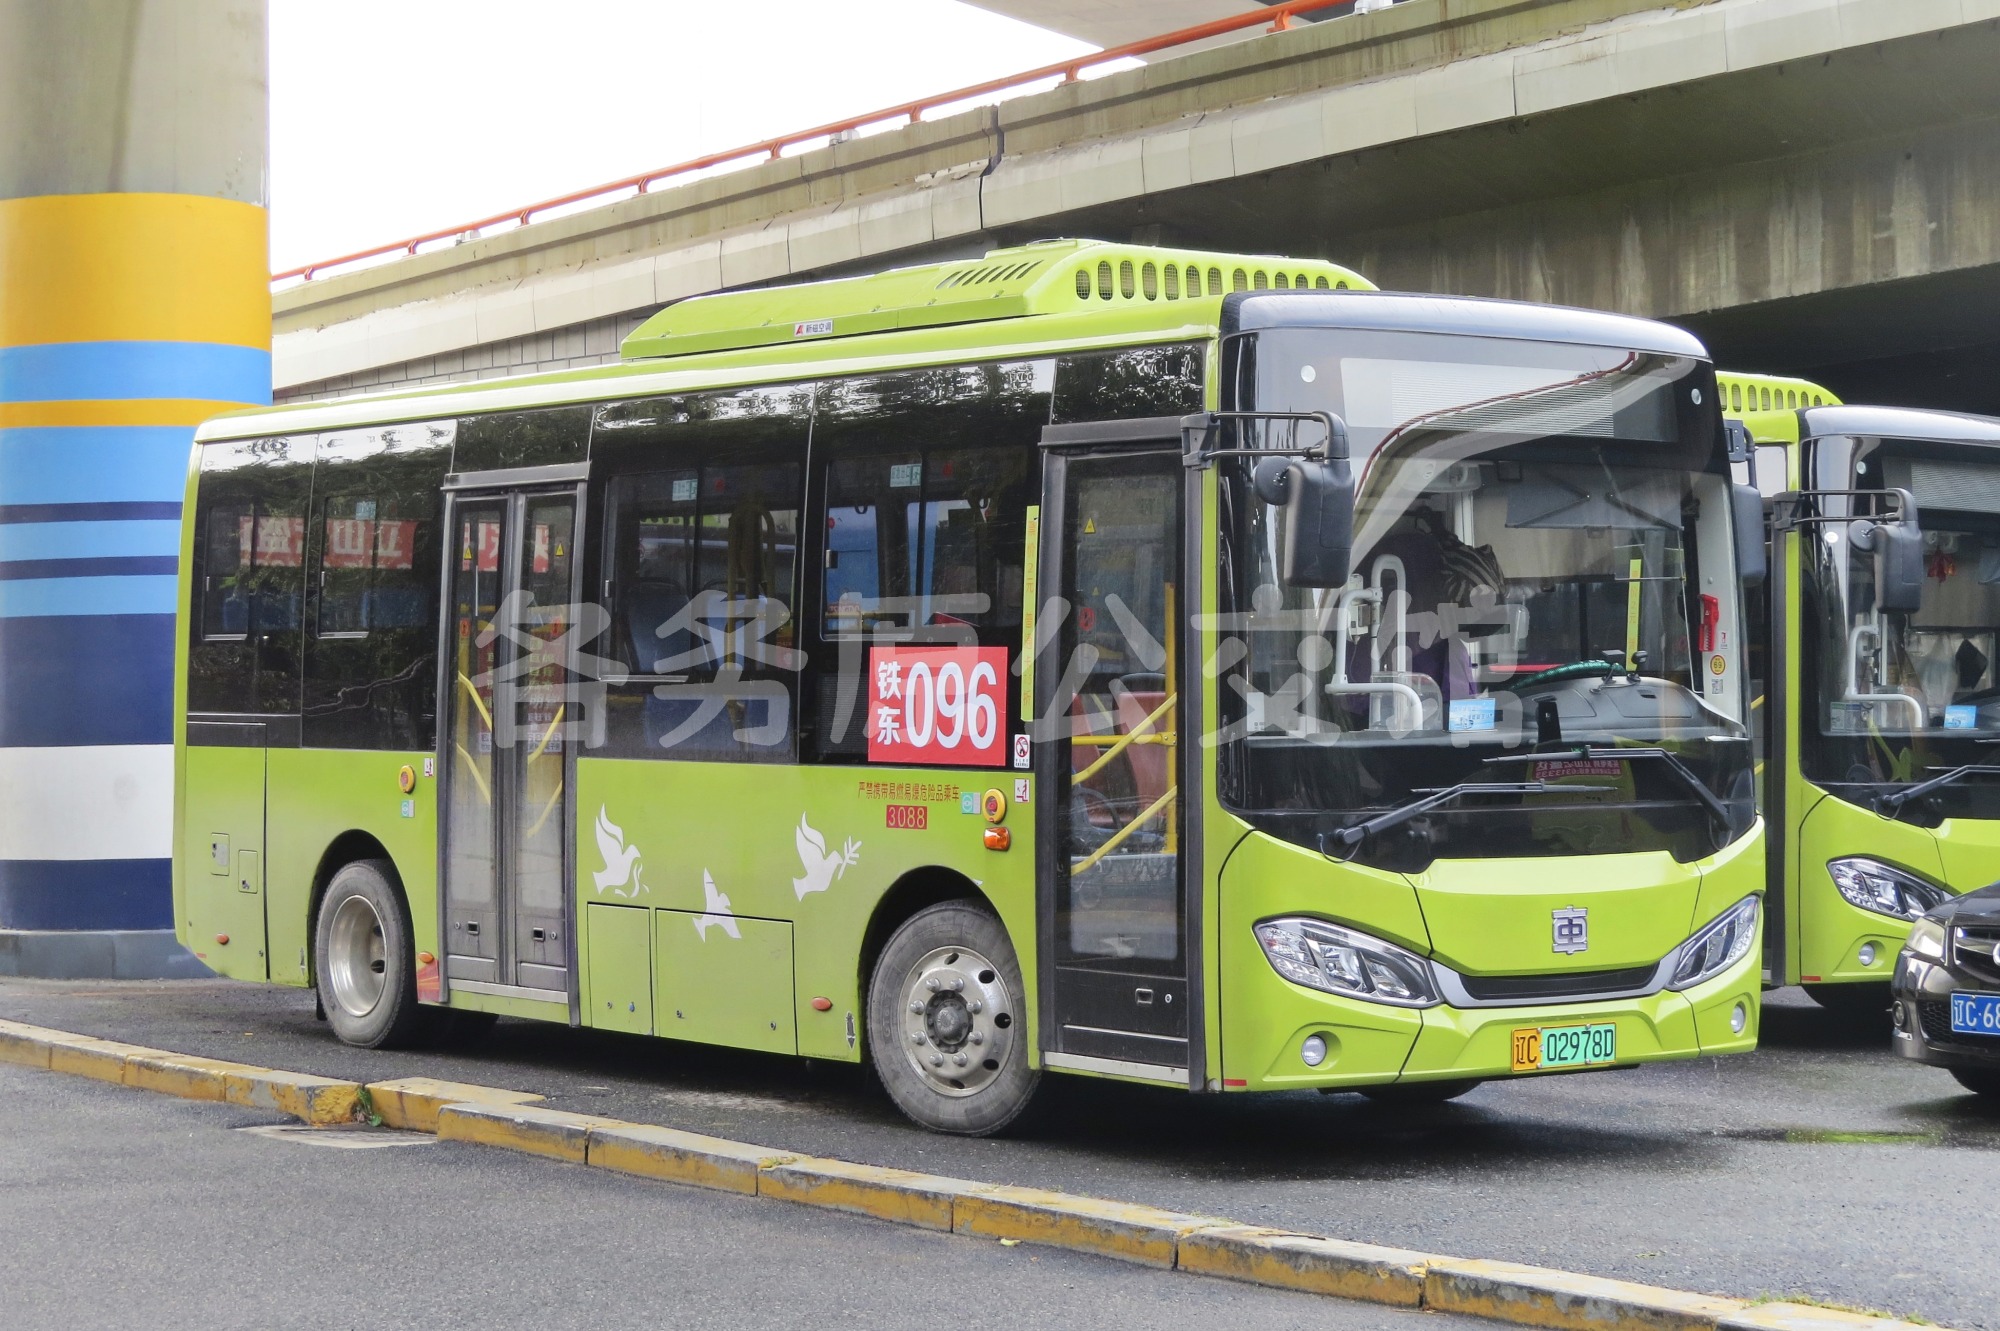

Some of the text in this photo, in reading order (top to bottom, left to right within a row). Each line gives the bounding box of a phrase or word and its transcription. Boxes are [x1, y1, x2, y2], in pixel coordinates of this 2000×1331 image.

[877, 661, 997, 750] 铁东 096
[858, 781, 960, 802] 严禁携带易燃易爆危险品乘车
[888, 806, 925, 828] 3088
